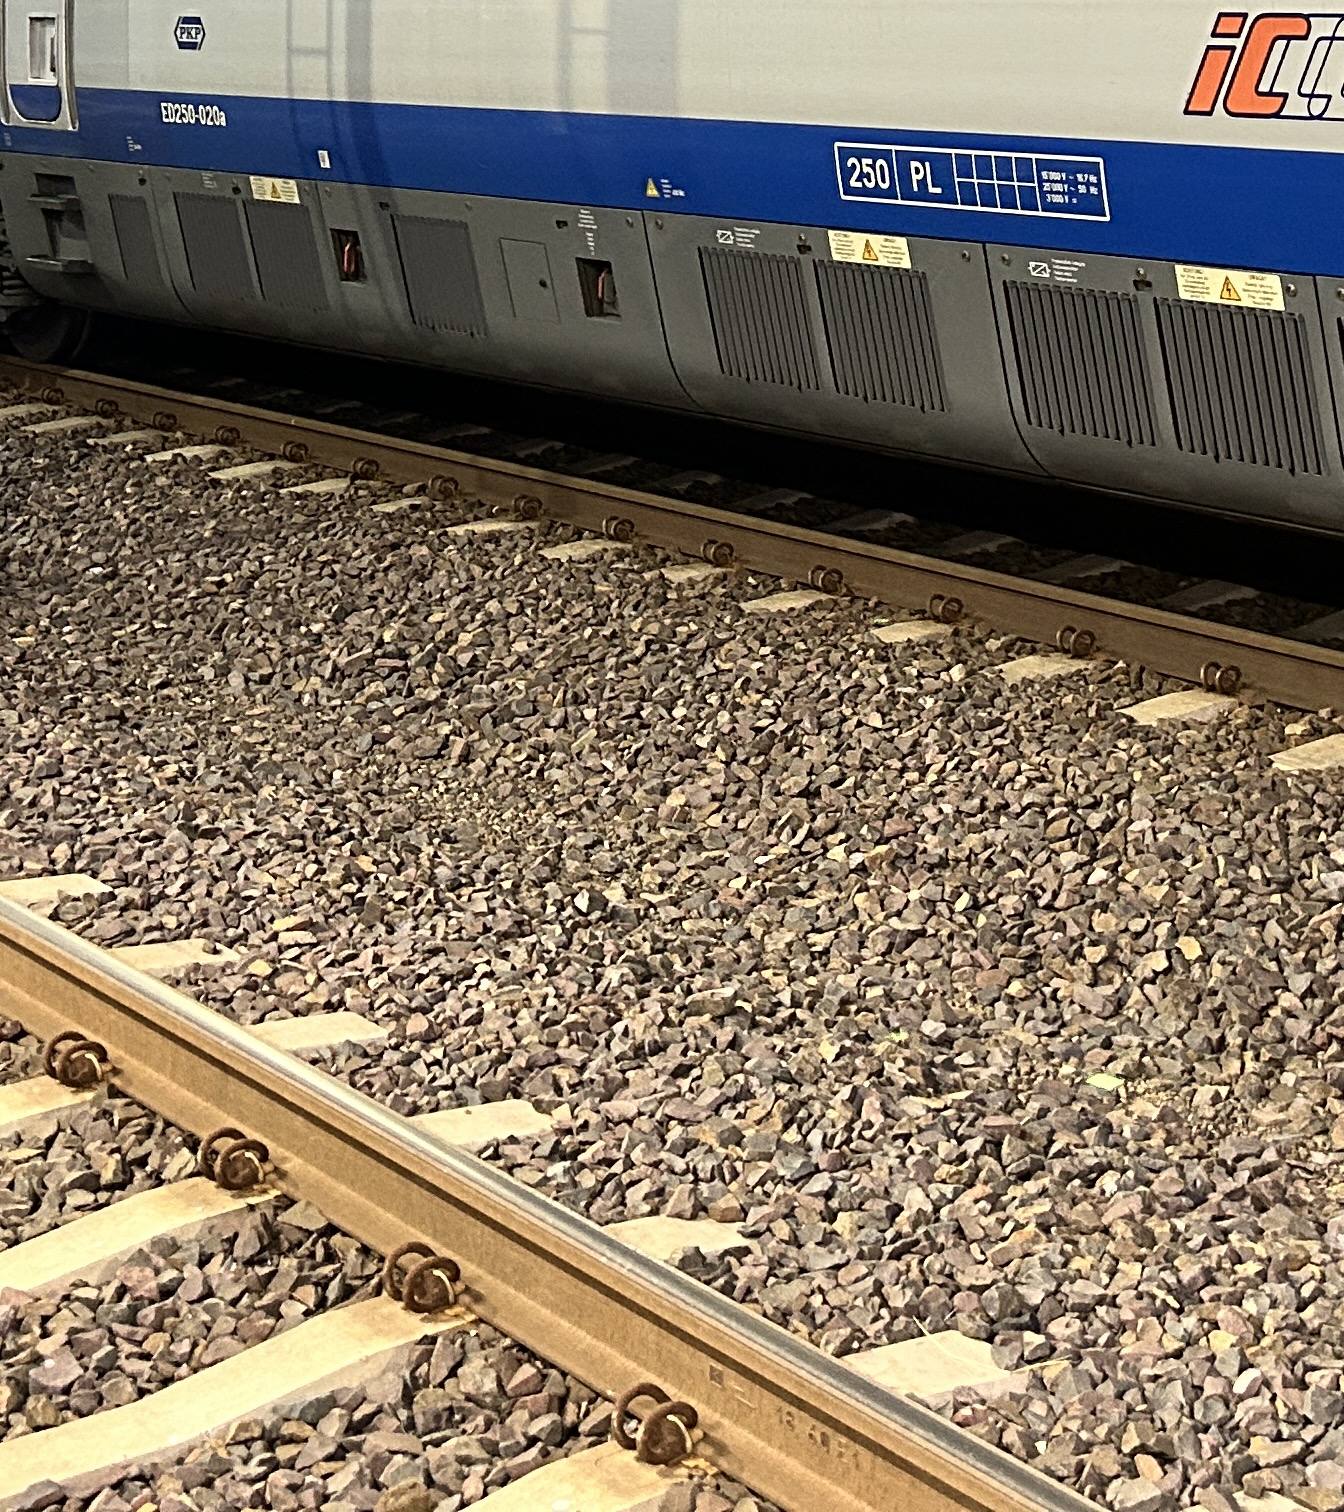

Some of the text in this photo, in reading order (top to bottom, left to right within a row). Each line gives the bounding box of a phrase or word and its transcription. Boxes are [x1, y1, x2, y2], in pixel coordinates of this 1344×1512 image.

[179, 26, 201, 40] PKP
[160, 102, 226, 127] ED250-020a
[846, 157, 943, 194] 250 PL
